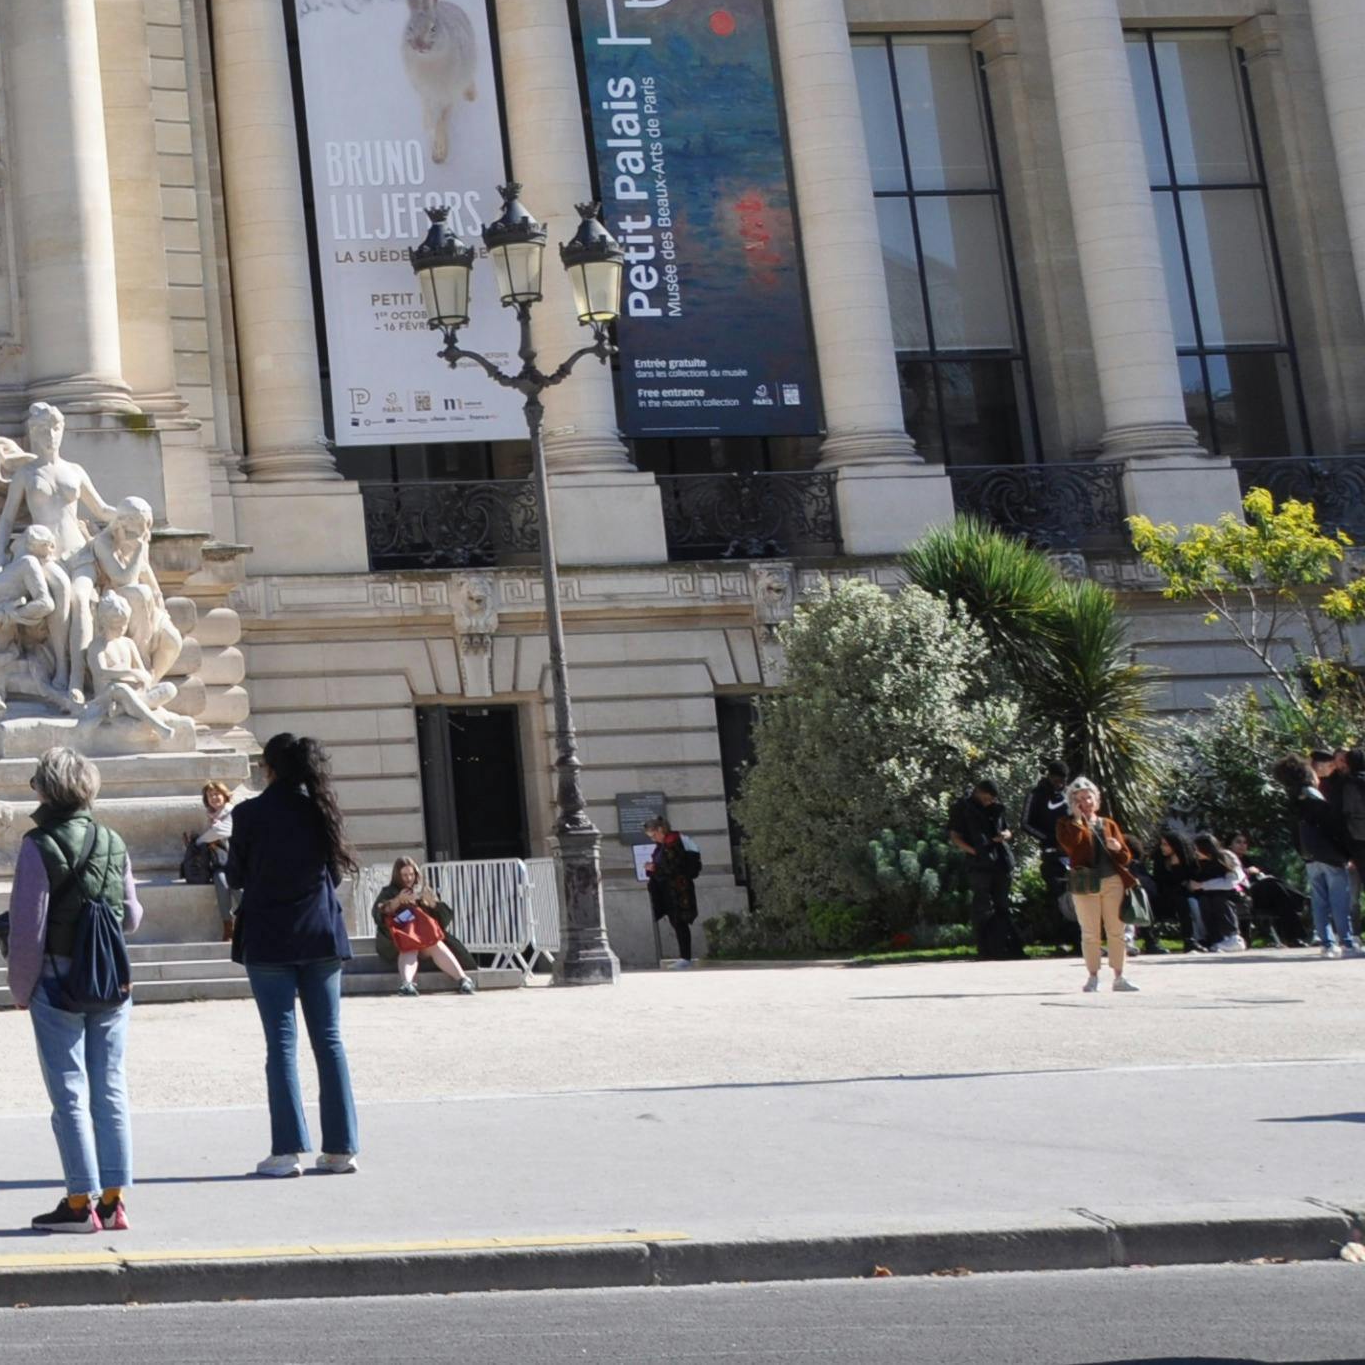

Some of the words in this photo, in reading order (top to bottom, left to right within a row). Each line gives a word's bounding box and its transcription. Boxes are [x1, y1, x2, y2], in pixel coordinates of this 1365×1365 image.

[640, 77, 659, 114] Paris
[645, 118, 661, 138] de
[602, 77, 649, 200] Palais
[325, 139, 426, 187] BRUNO
[650, 142, 671, 227] Beaux-Arts
[335, 251, 353, 263] LA
[359, 247, 410, 263] SUÈDE
[660, 231, 675, 260] des
[617, 215, 662, 317] Petit
[371, 292, 413, 306] PETIT
[662, 264, 682, 317] Musée
[391, 310, 428, 320] OCTOB
[384, 323, 395, 331] 16
[634, 359, 667, 369] Entrée
[669, 358, 707, 370] gratuite
[635, 370, 654, 378] dans
[669, 369, 709, 378] collections
[710, 369, 720, 377] du
[637, 389, 659, 398] Free
[661, 388, 705, 398] entrance
